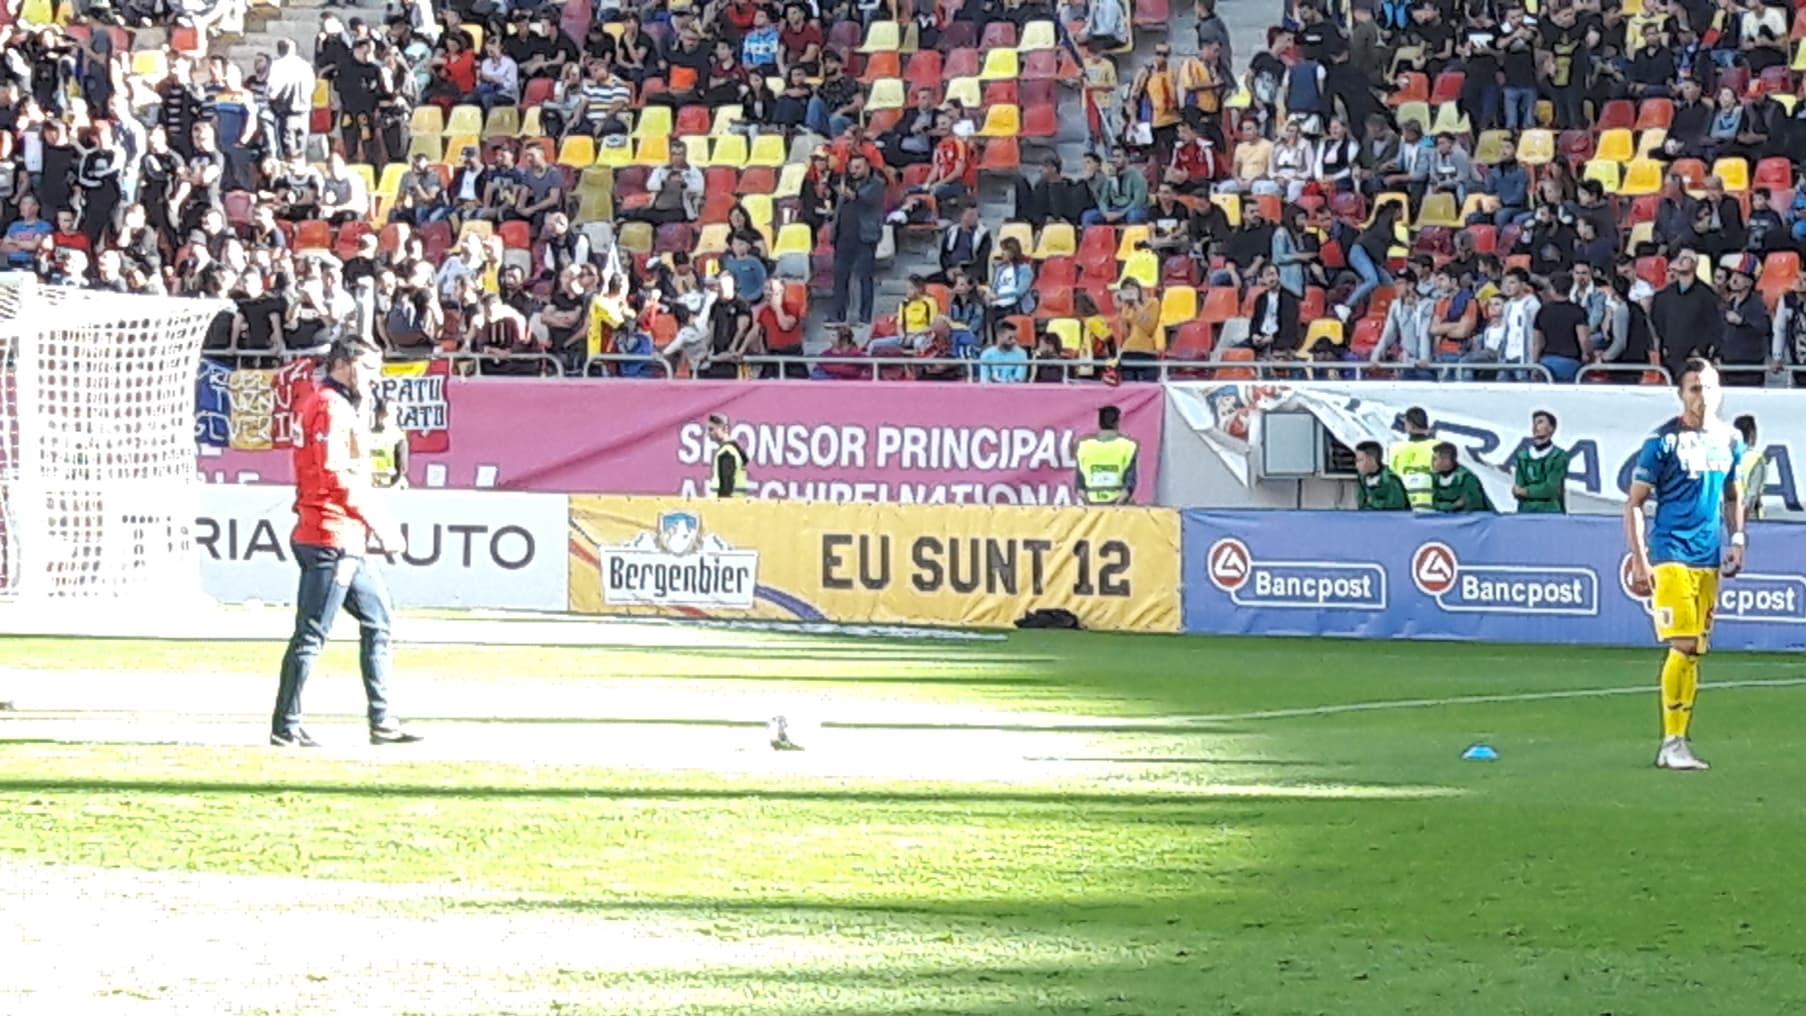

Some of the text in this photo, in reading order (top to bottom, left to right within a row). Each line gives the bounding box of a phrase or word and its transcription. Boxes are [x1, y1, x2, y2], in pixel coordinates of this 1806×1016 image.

[877, 427, 1078, 470] PRINCIPAL
[195, 517, 536, 570] RIA AUTO
[610, 555, 749, 598] Bergenbier
[822, 534, 1132, 597] EU SUNT 12
[1255, 570, 1373, 603] Bancpost
[1462, 575, 1584, 607] Bancpost
[1720, 586, 1796, 615] cpost
